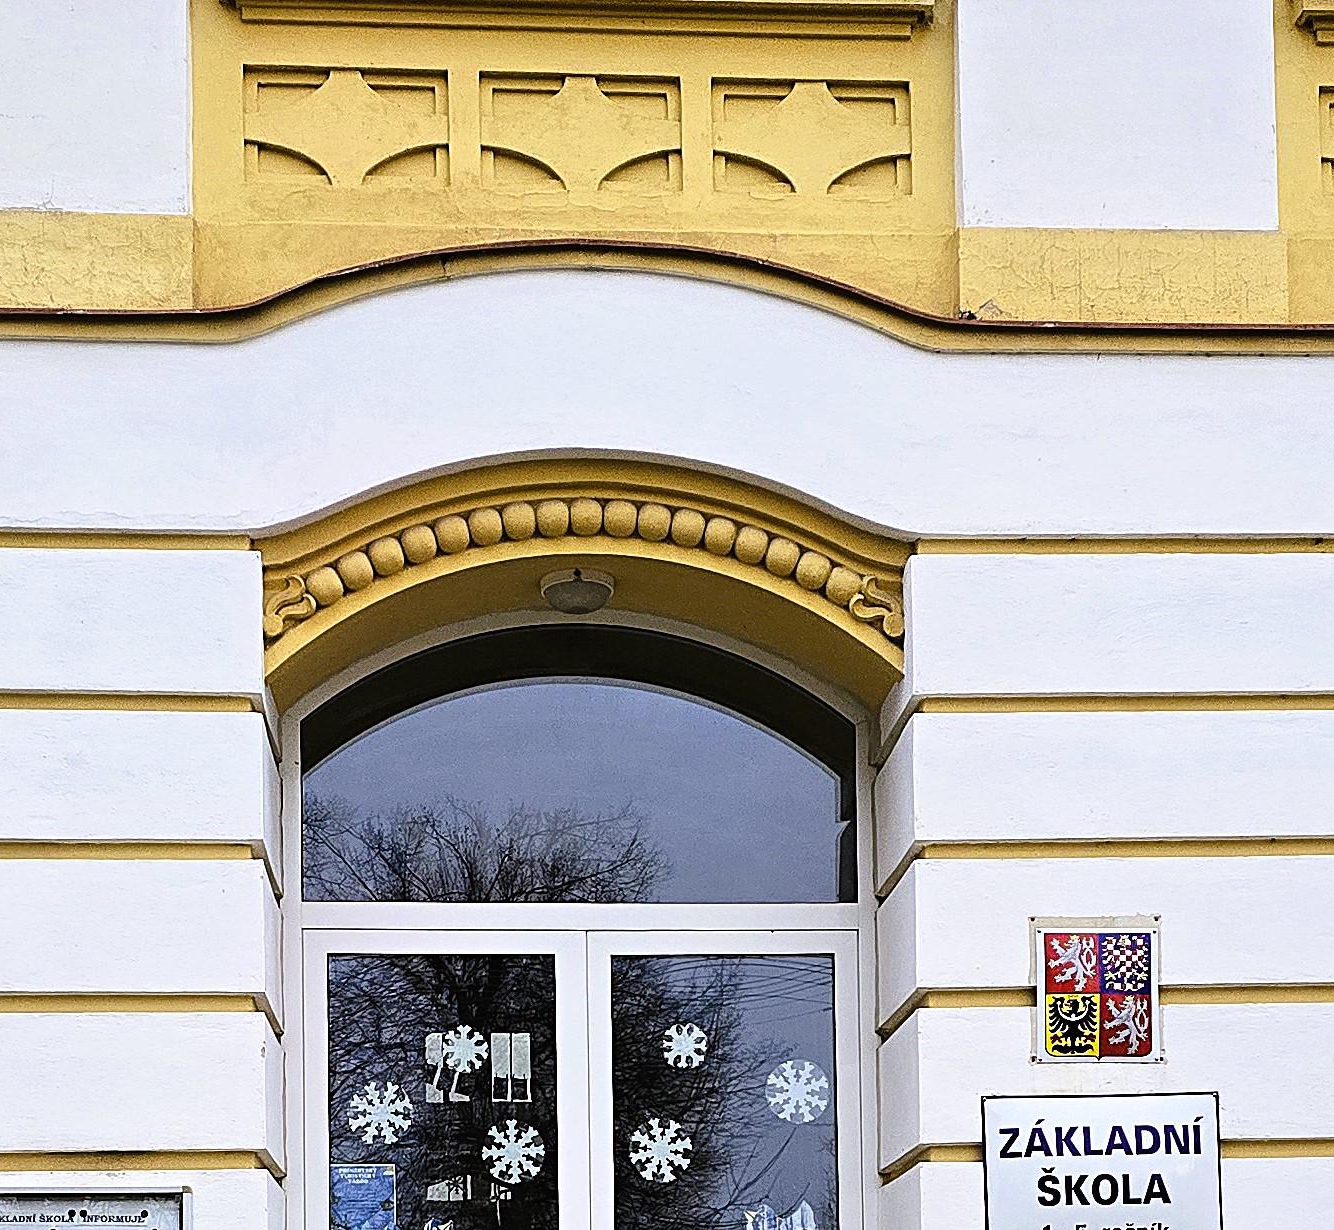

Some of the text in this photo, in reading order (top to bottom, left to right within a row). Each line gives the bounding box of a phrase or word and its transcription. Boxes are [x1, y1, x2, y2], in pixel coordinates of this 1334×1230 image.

[999, 1116, 1203, 1158] ZÁKLADNÍ
[1037, 1167, 1172, 1206] ŠKOLA
[39, 1214, 75, 1223] ŠKOLA
[82, 1213, 146, 1223] INFORMUJE
